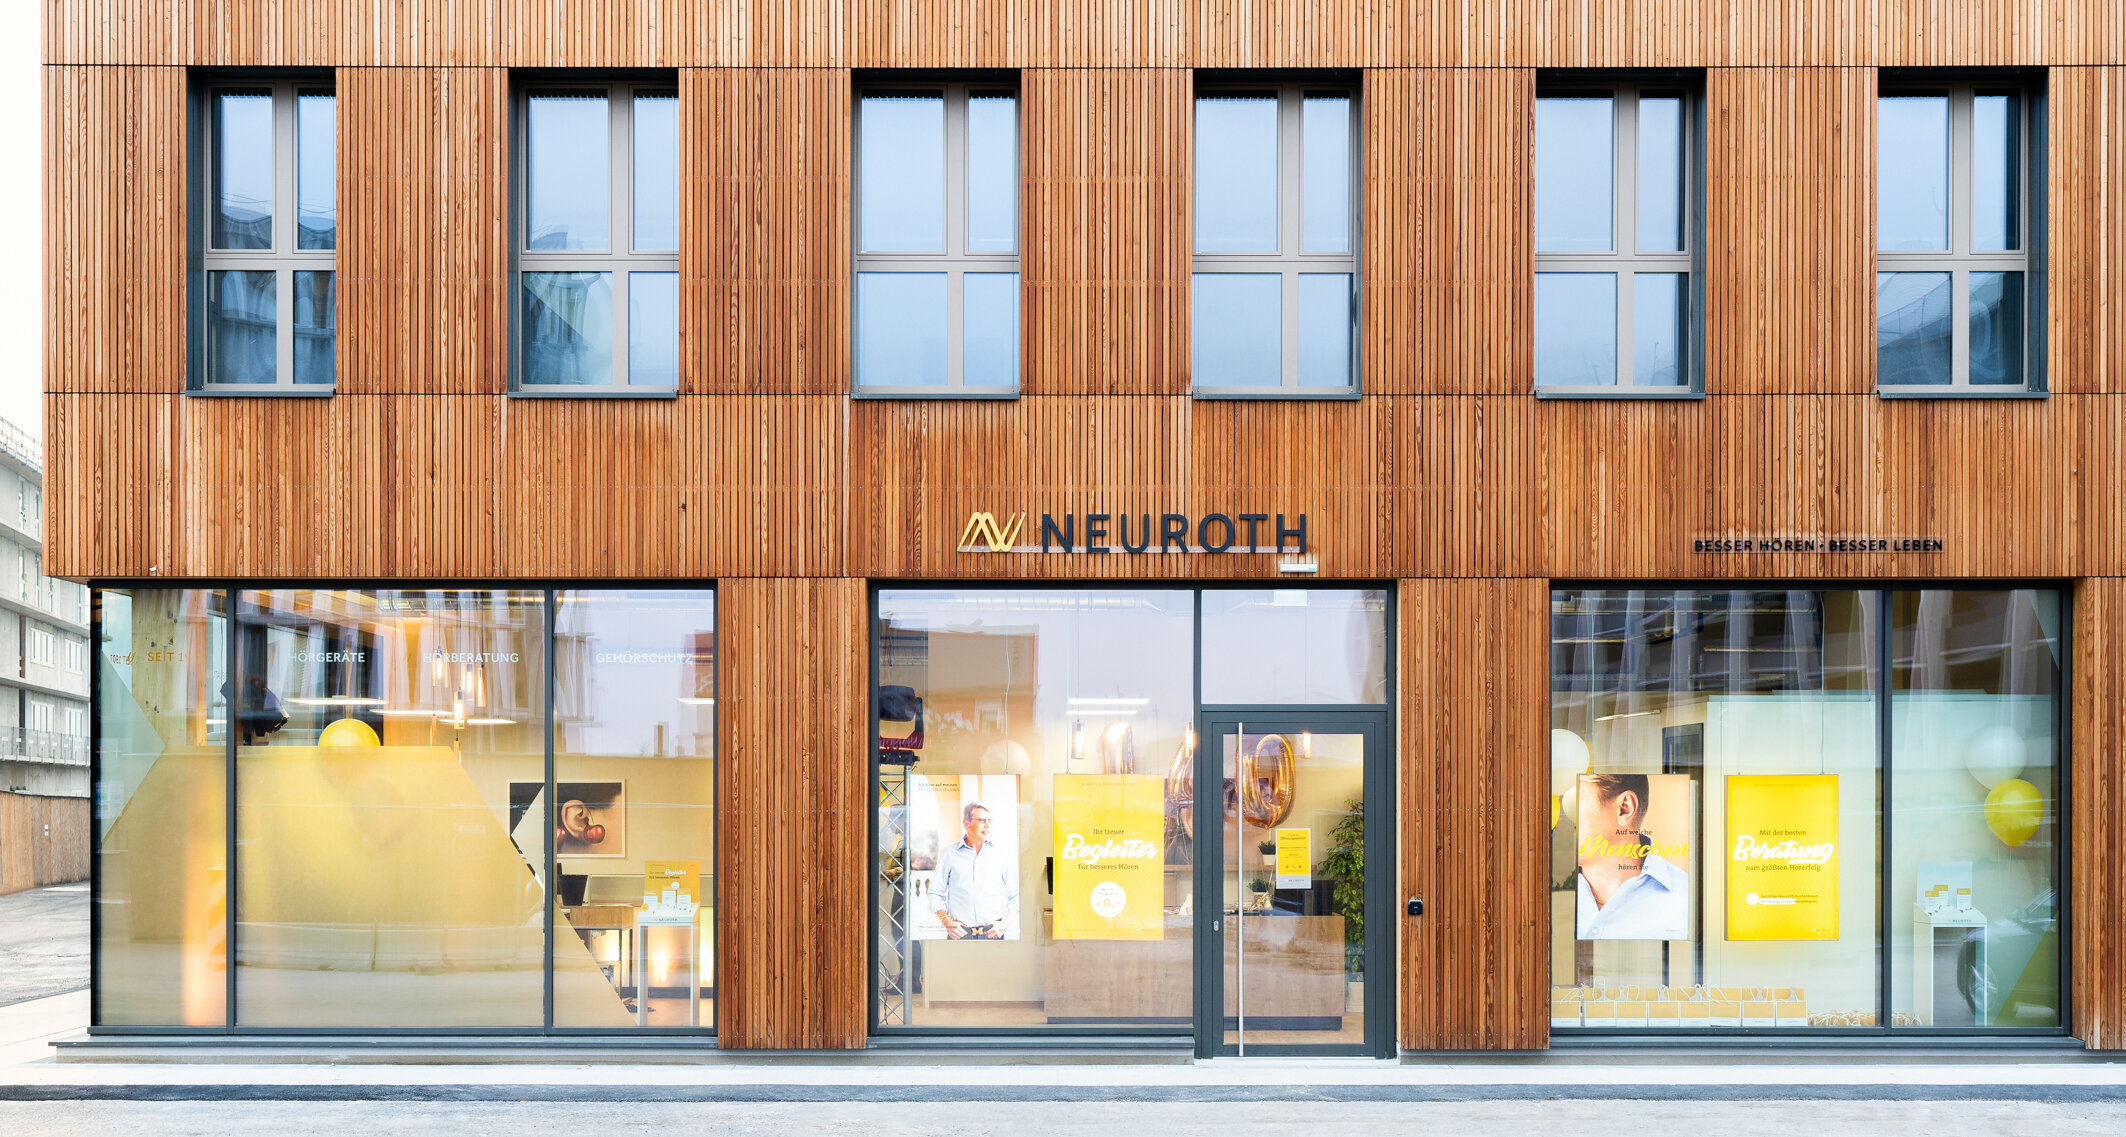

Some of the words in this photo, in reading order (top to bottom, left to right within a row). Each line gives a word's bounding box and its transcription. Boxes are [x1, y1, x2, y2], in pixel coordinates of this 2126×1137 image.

[1042, 513, 1306, 553] NEUROTH
[1695, 540, 1752, 551] BESSER
[1760, 538, 1815, 551] HÖREN
[1830, 540, 1887, 551] BESSER
[1894, 540, 1942, 551] LEBEN
[147, 652, 174, 662] SEIT
[289, 650, 365, 663] HÖRGERÄTE
[423, 650, 519, 663] HÖRBERATUNG
[595, 651, 693, 663] GEHÖRSCHUTZ
[1062, 833, 1159, 864] Begleiter
[1579, 835, 1689, 859] Menschen
[1733, 834, 1834, 864] Beratung
[1761, 864, 1788, 872] größten
[1789, 864, 1821, 872] Hörerfolg
